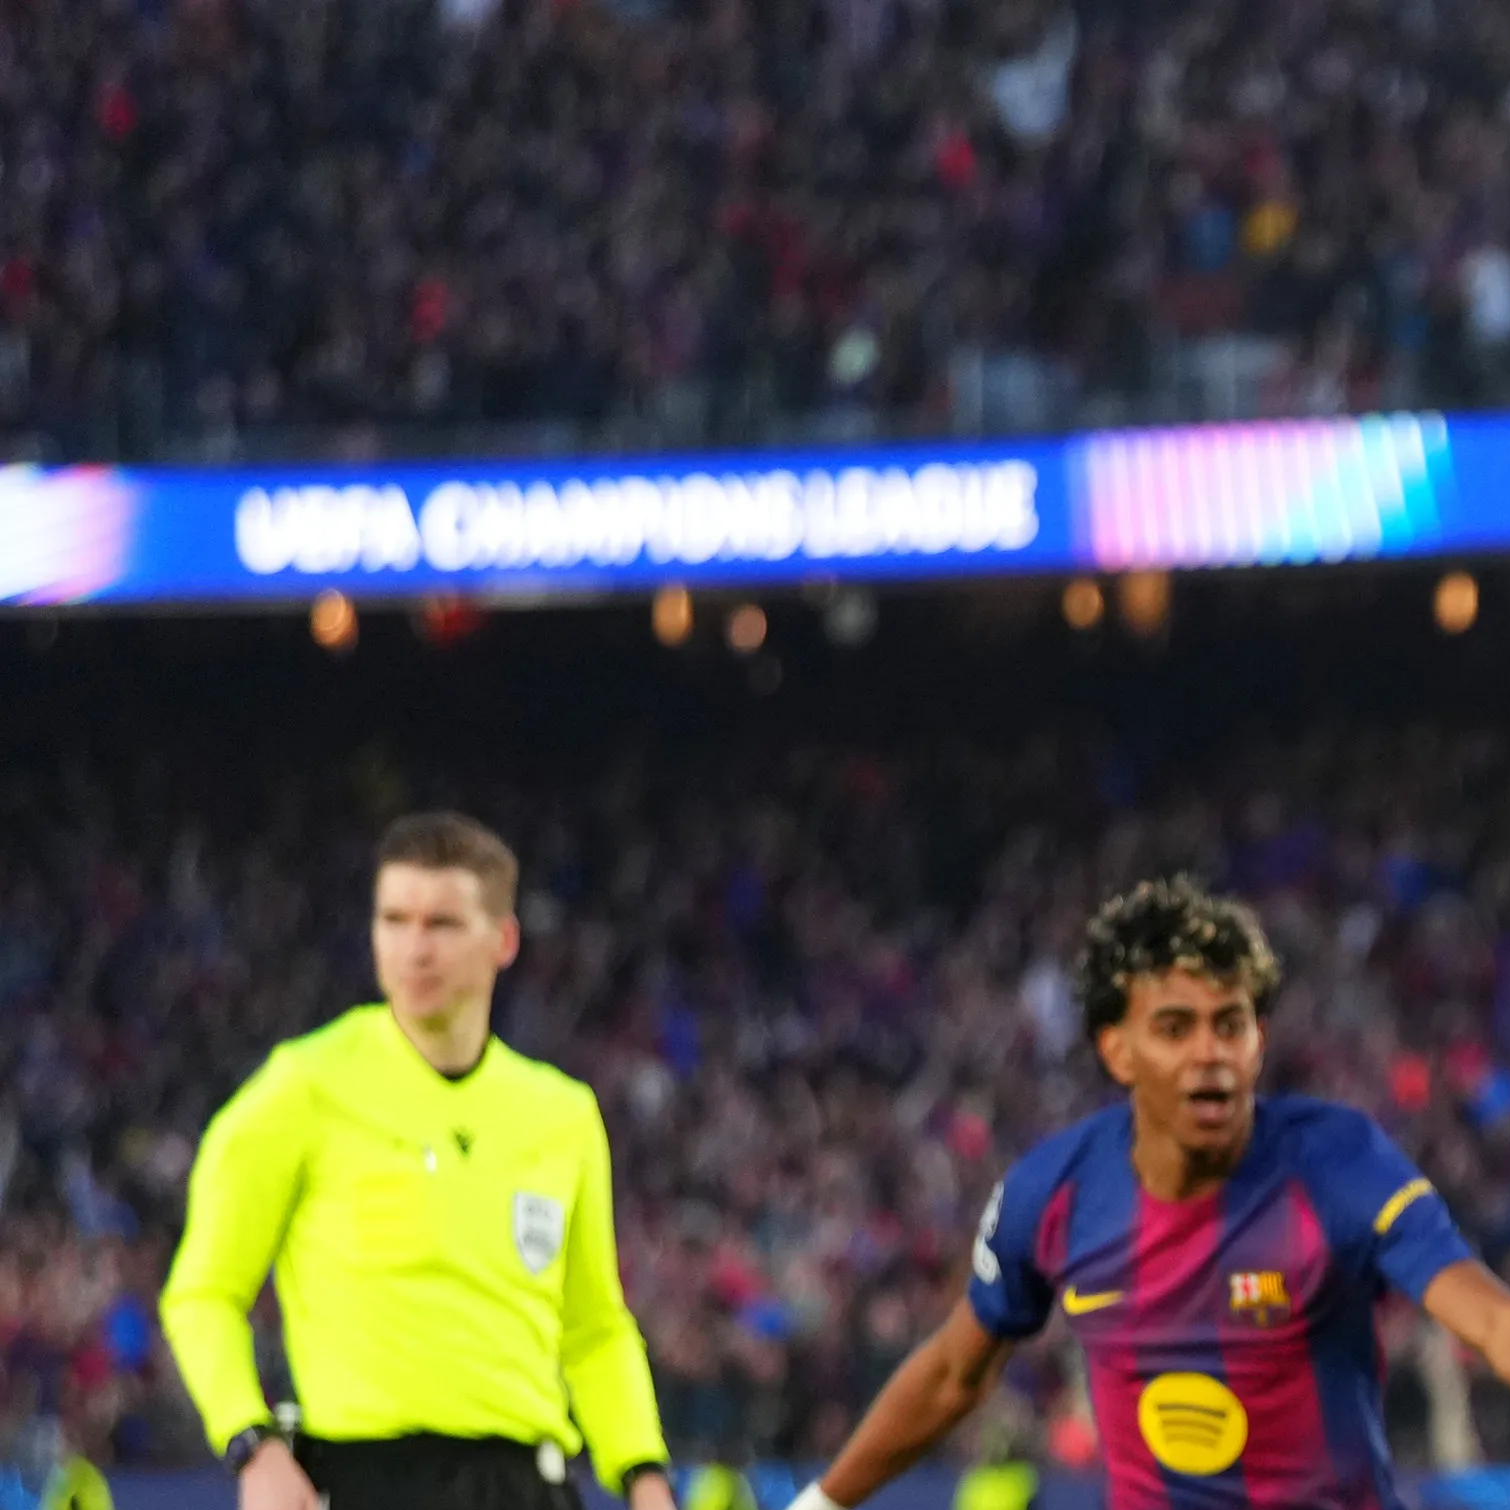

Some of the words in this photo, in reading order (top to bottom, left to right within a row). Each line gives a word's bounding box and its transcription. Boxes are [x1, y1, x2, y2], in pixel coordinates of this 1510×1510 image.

[235, 484, 422, 574] UEFA
[418, 469, 803, 572] CHAMPIONS
[800, 459, 1040, 559] LEAGUE
